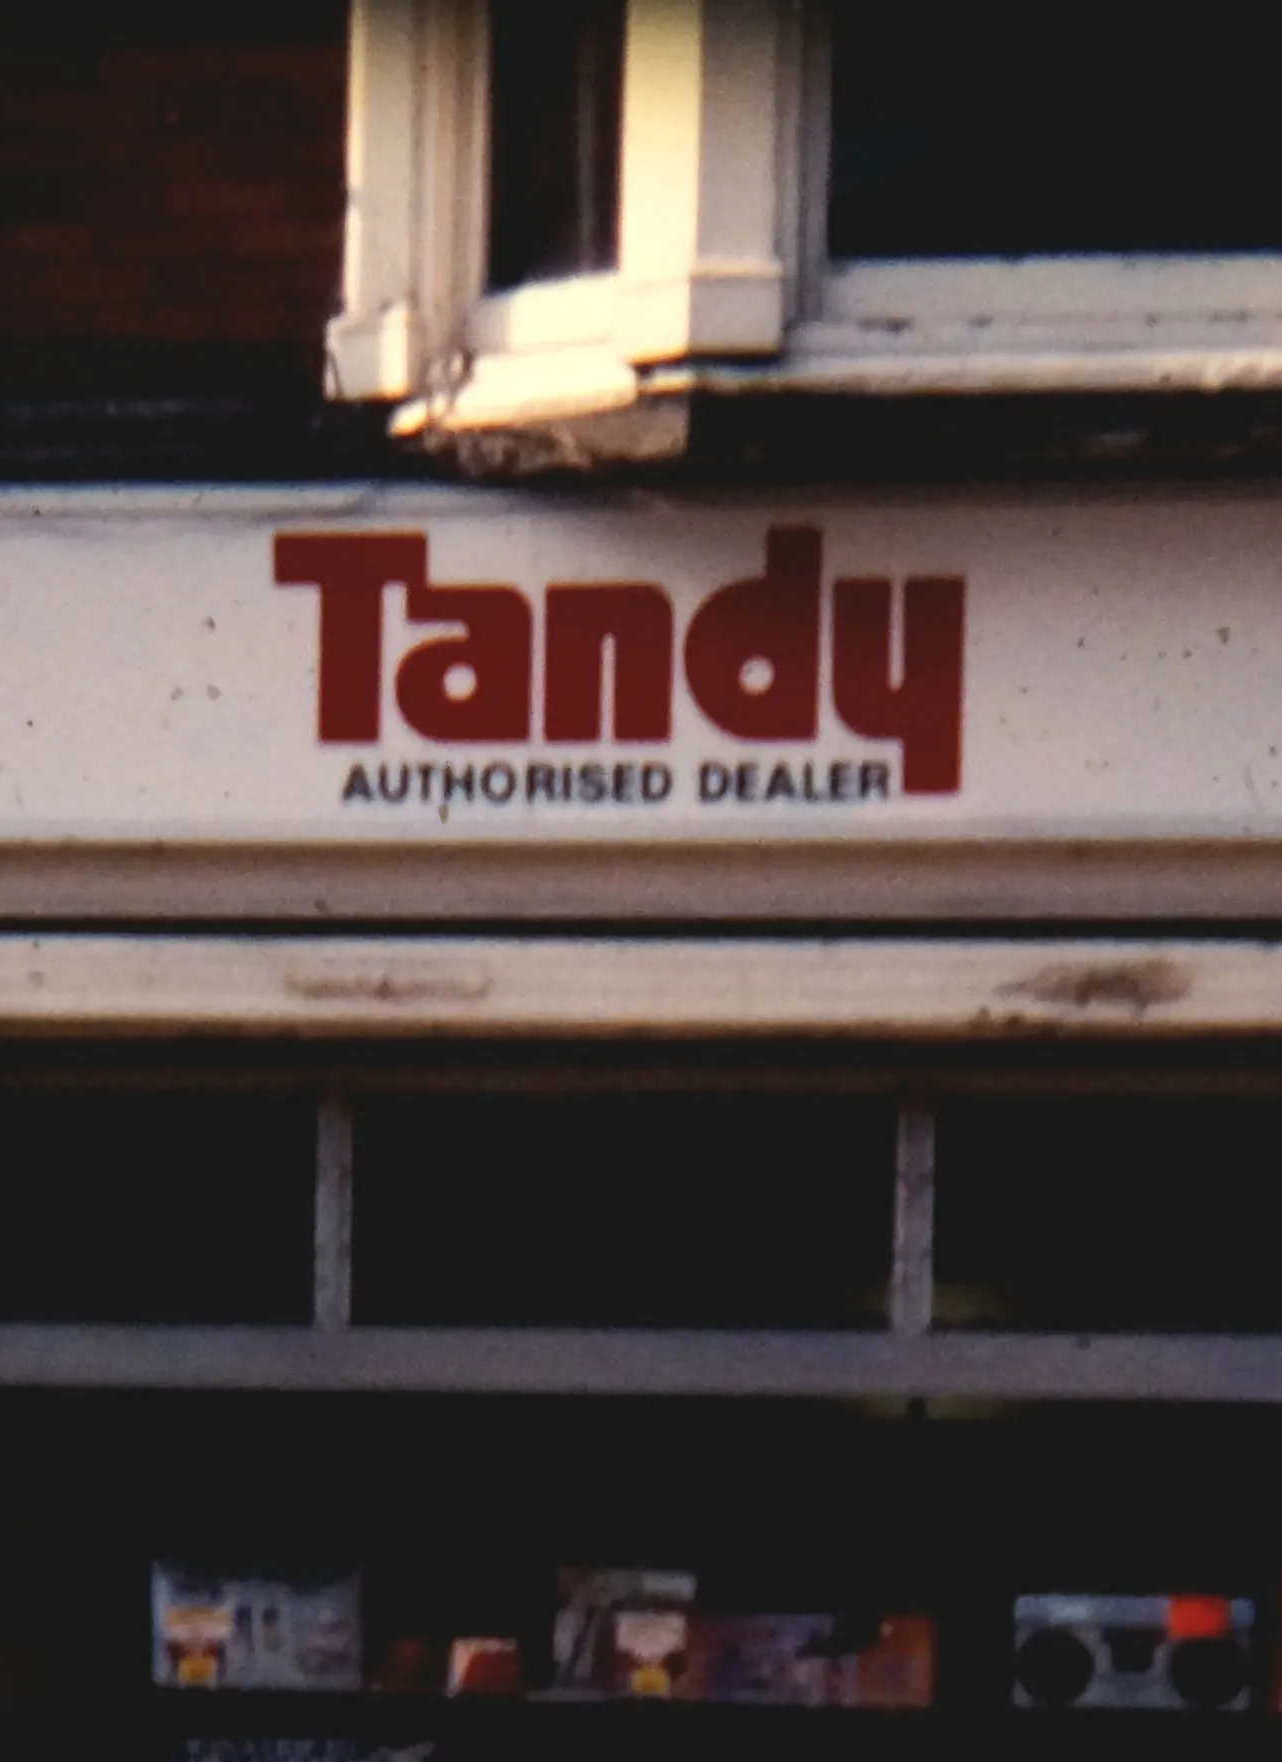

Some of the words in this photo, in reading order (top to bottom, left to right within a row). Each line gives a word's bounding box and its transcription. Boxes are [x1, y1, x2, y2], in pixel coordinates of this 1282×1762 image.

[272, 525, 966, 796] Tandy
[342, 761, 673, 804] AUTHORISED
[698, 760, 891, 803] DEALER
